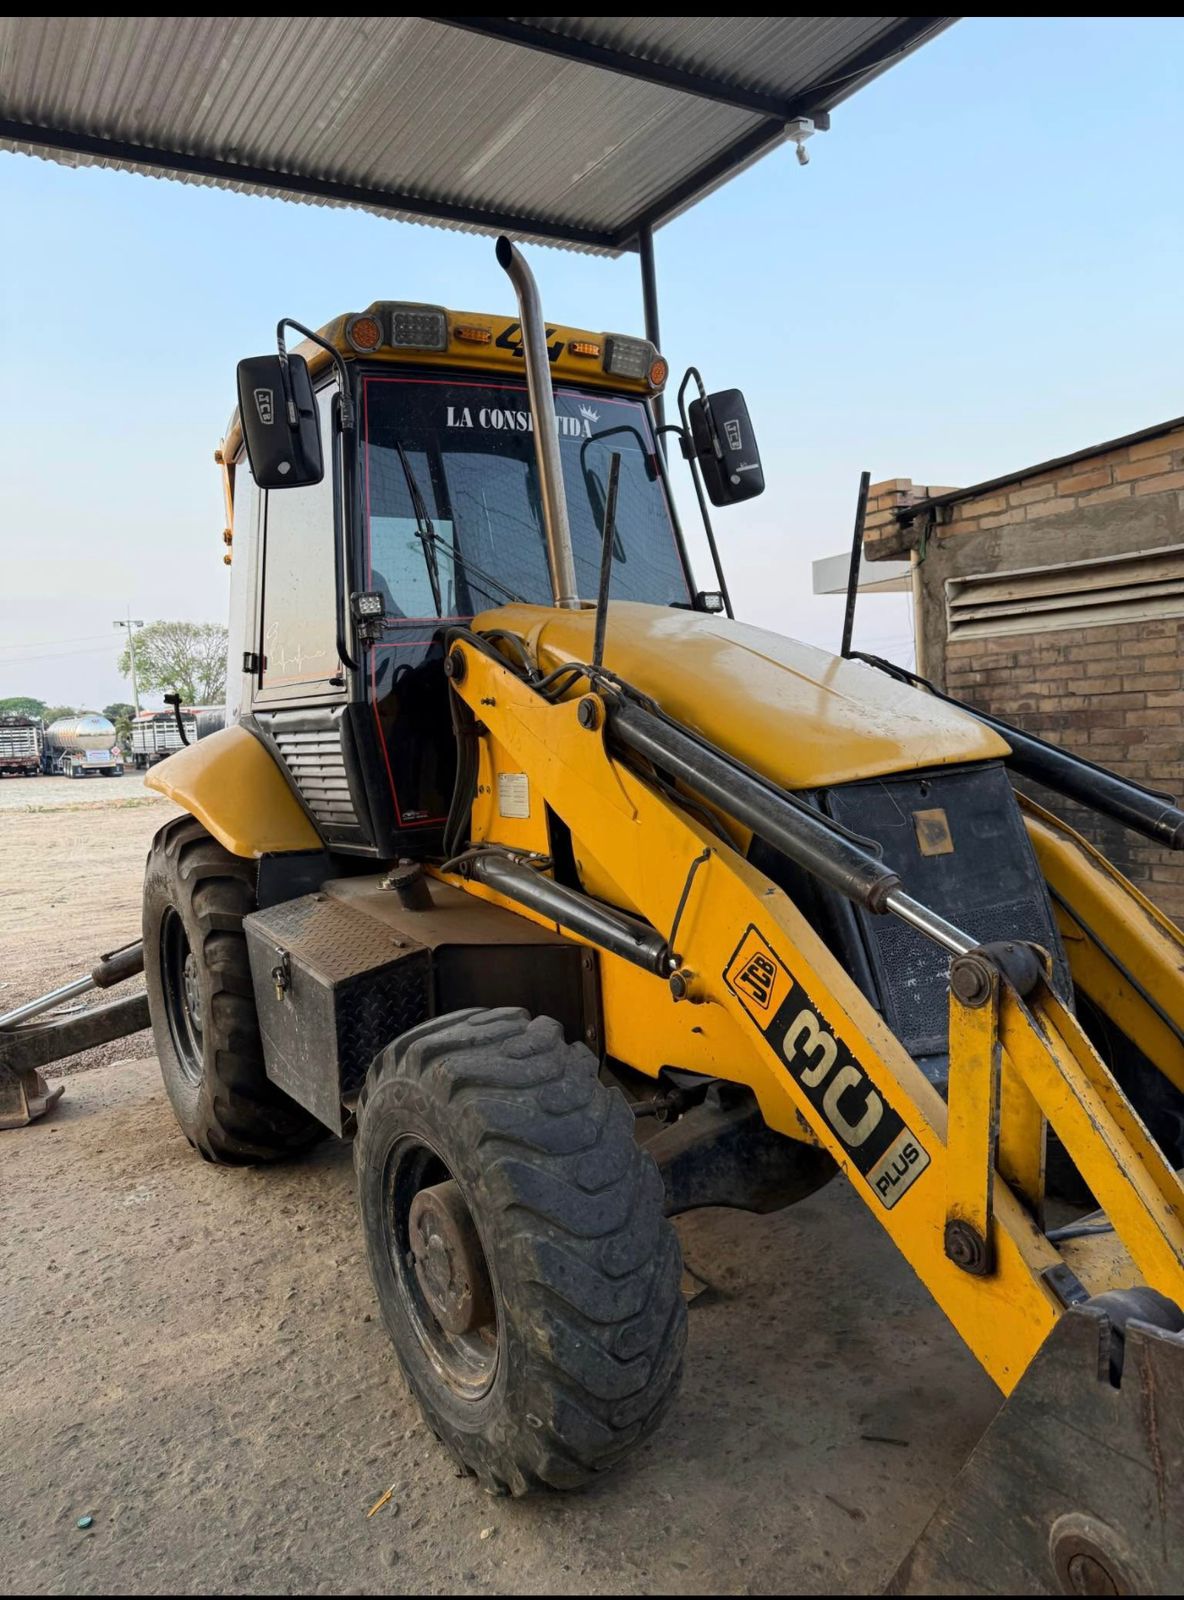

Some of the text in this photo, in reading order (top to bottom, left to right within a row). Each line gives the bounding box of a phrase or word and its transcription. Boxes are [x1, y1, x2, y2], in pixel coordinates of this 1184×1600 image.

[257, 392, 272, 421] JCB
[446, 406, 593, 438] LA CONSTIDA
[740, 956, 776, 1004] JCB
[783, 1009, 883, 1148] 3C
[876, 1142, 919, 1197] PLUS
